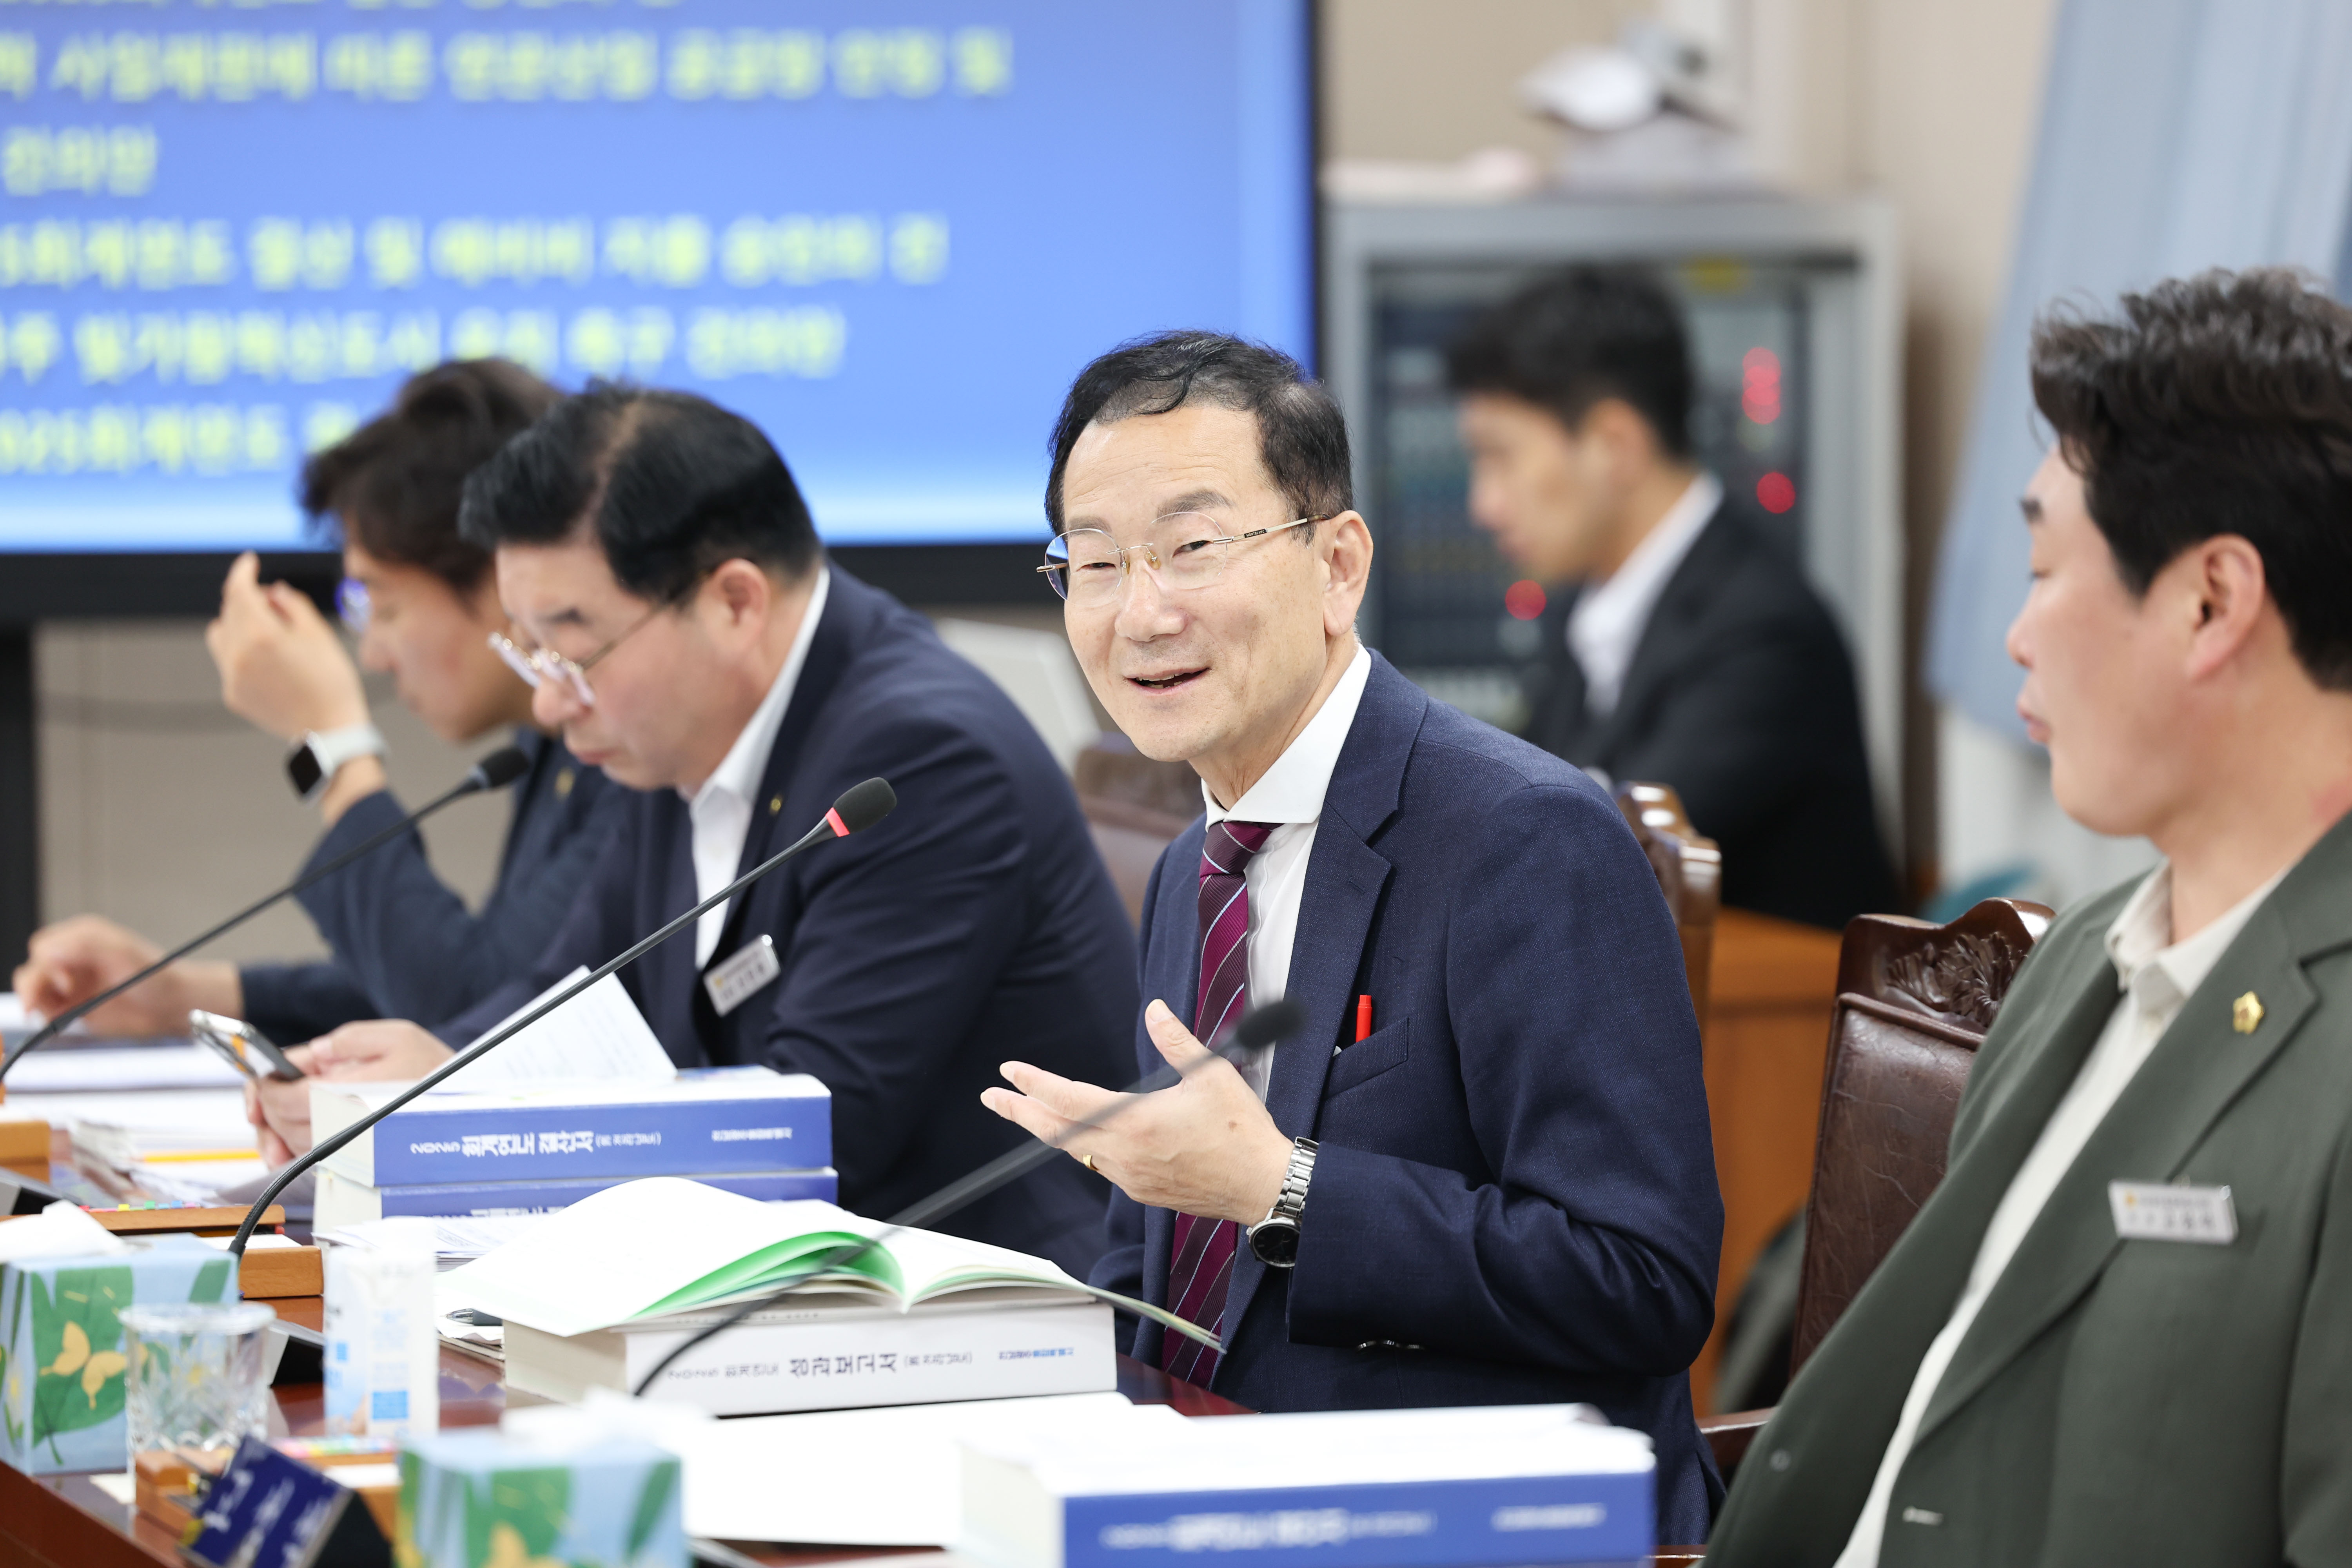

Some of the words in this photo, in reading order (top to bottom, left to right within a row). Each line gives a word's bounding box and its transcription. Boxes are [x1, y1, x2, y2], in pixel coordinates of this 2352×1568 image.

[410, 1141, 461, 1154] 2025
[461, 1132, 535, 1157] 회계연도
[538, 1130, 594, 1154] 결산서
[789, 1353, 898, 1378] 성과보고서
